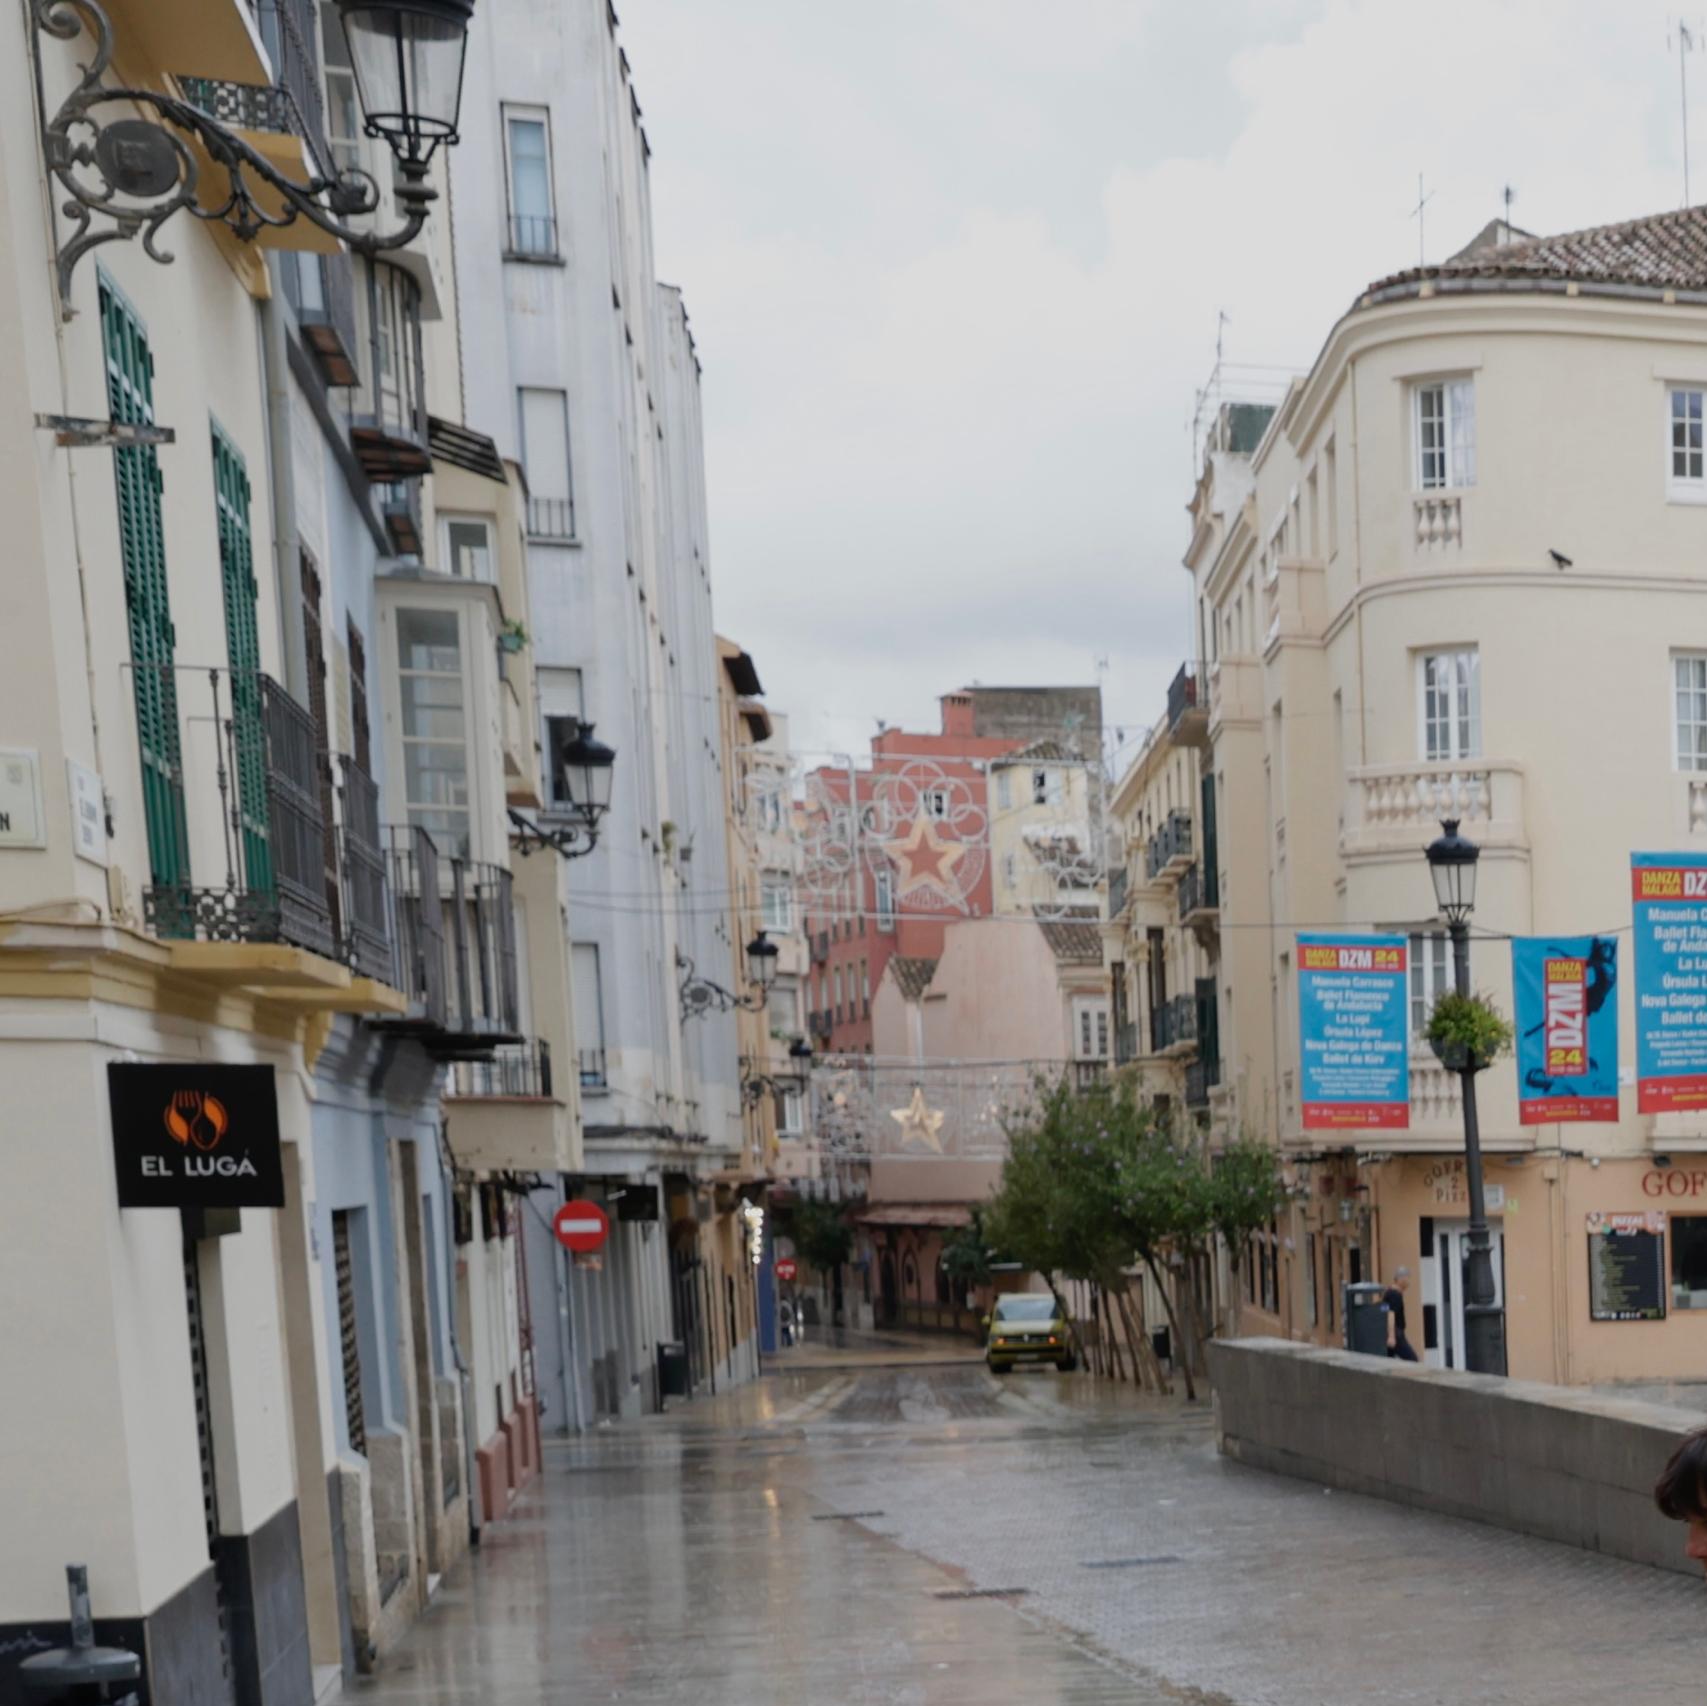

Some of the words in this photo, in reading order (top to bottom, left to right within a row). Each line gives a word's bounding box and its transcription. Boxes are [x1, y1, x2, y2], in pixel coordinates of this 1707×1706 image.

[1641, 872, 1681, 884] DANZA
[1648, 908, 1698, 922] Manuela
[1654, 926, 1687, 940] Ballet
[1662, 940, 1677, 953] de
[1339, 950, 1372, 968] DZM
[1375, 949, 1399, 962] 24
[1678, 957, 1693, 970] La
[1662, 972, 1699, 989] Úrsula
[1641, 994, 1667, 1008] Nova
[1669, 993, 1706, 1008] Galega
[1548, 983, 1584, 1048] DZM
[1662, 1011, 1693, 1025] Ballet
[1550, 1049, 1583, 1065] 24
[141, 1155, 173, 1177] EL
